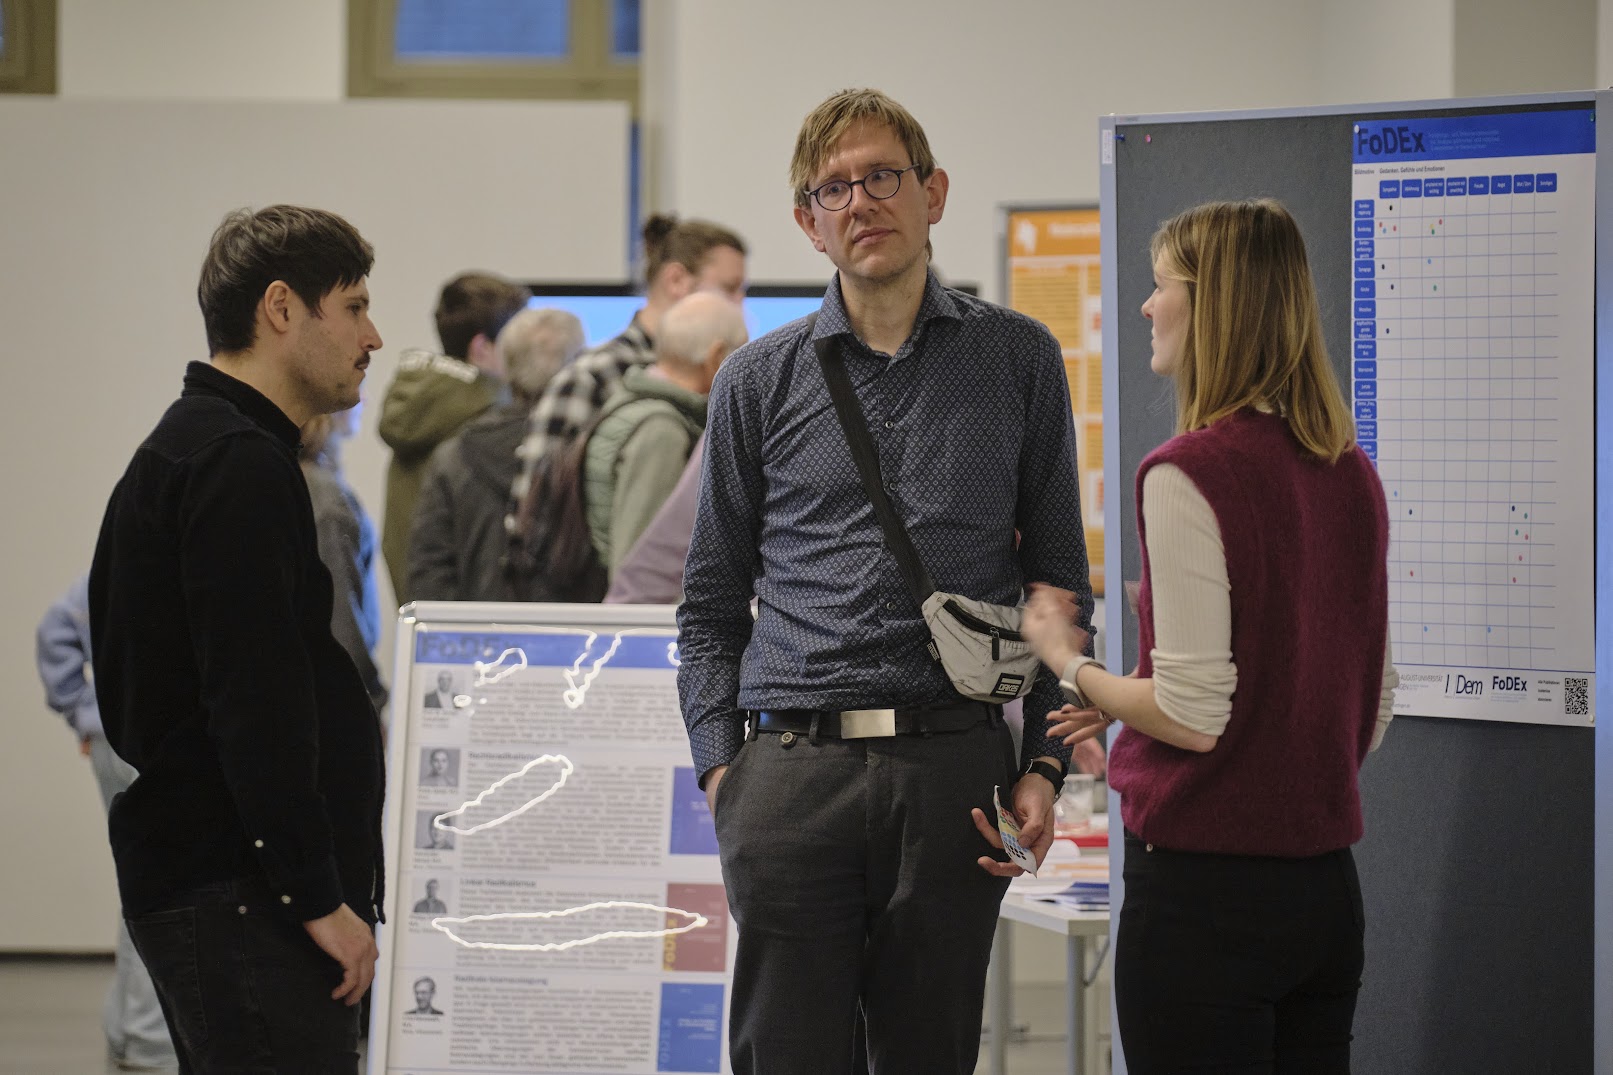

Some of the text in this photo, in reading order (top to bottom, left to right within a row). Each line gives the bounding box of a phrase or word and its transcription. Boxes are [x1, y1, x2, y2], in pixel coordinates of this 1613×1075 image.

[1358, 126, 1426, 155] FoDEx
[1456, 675, 1483, 695] Dem
[1492, 676, 1527, 691] FoDEx
